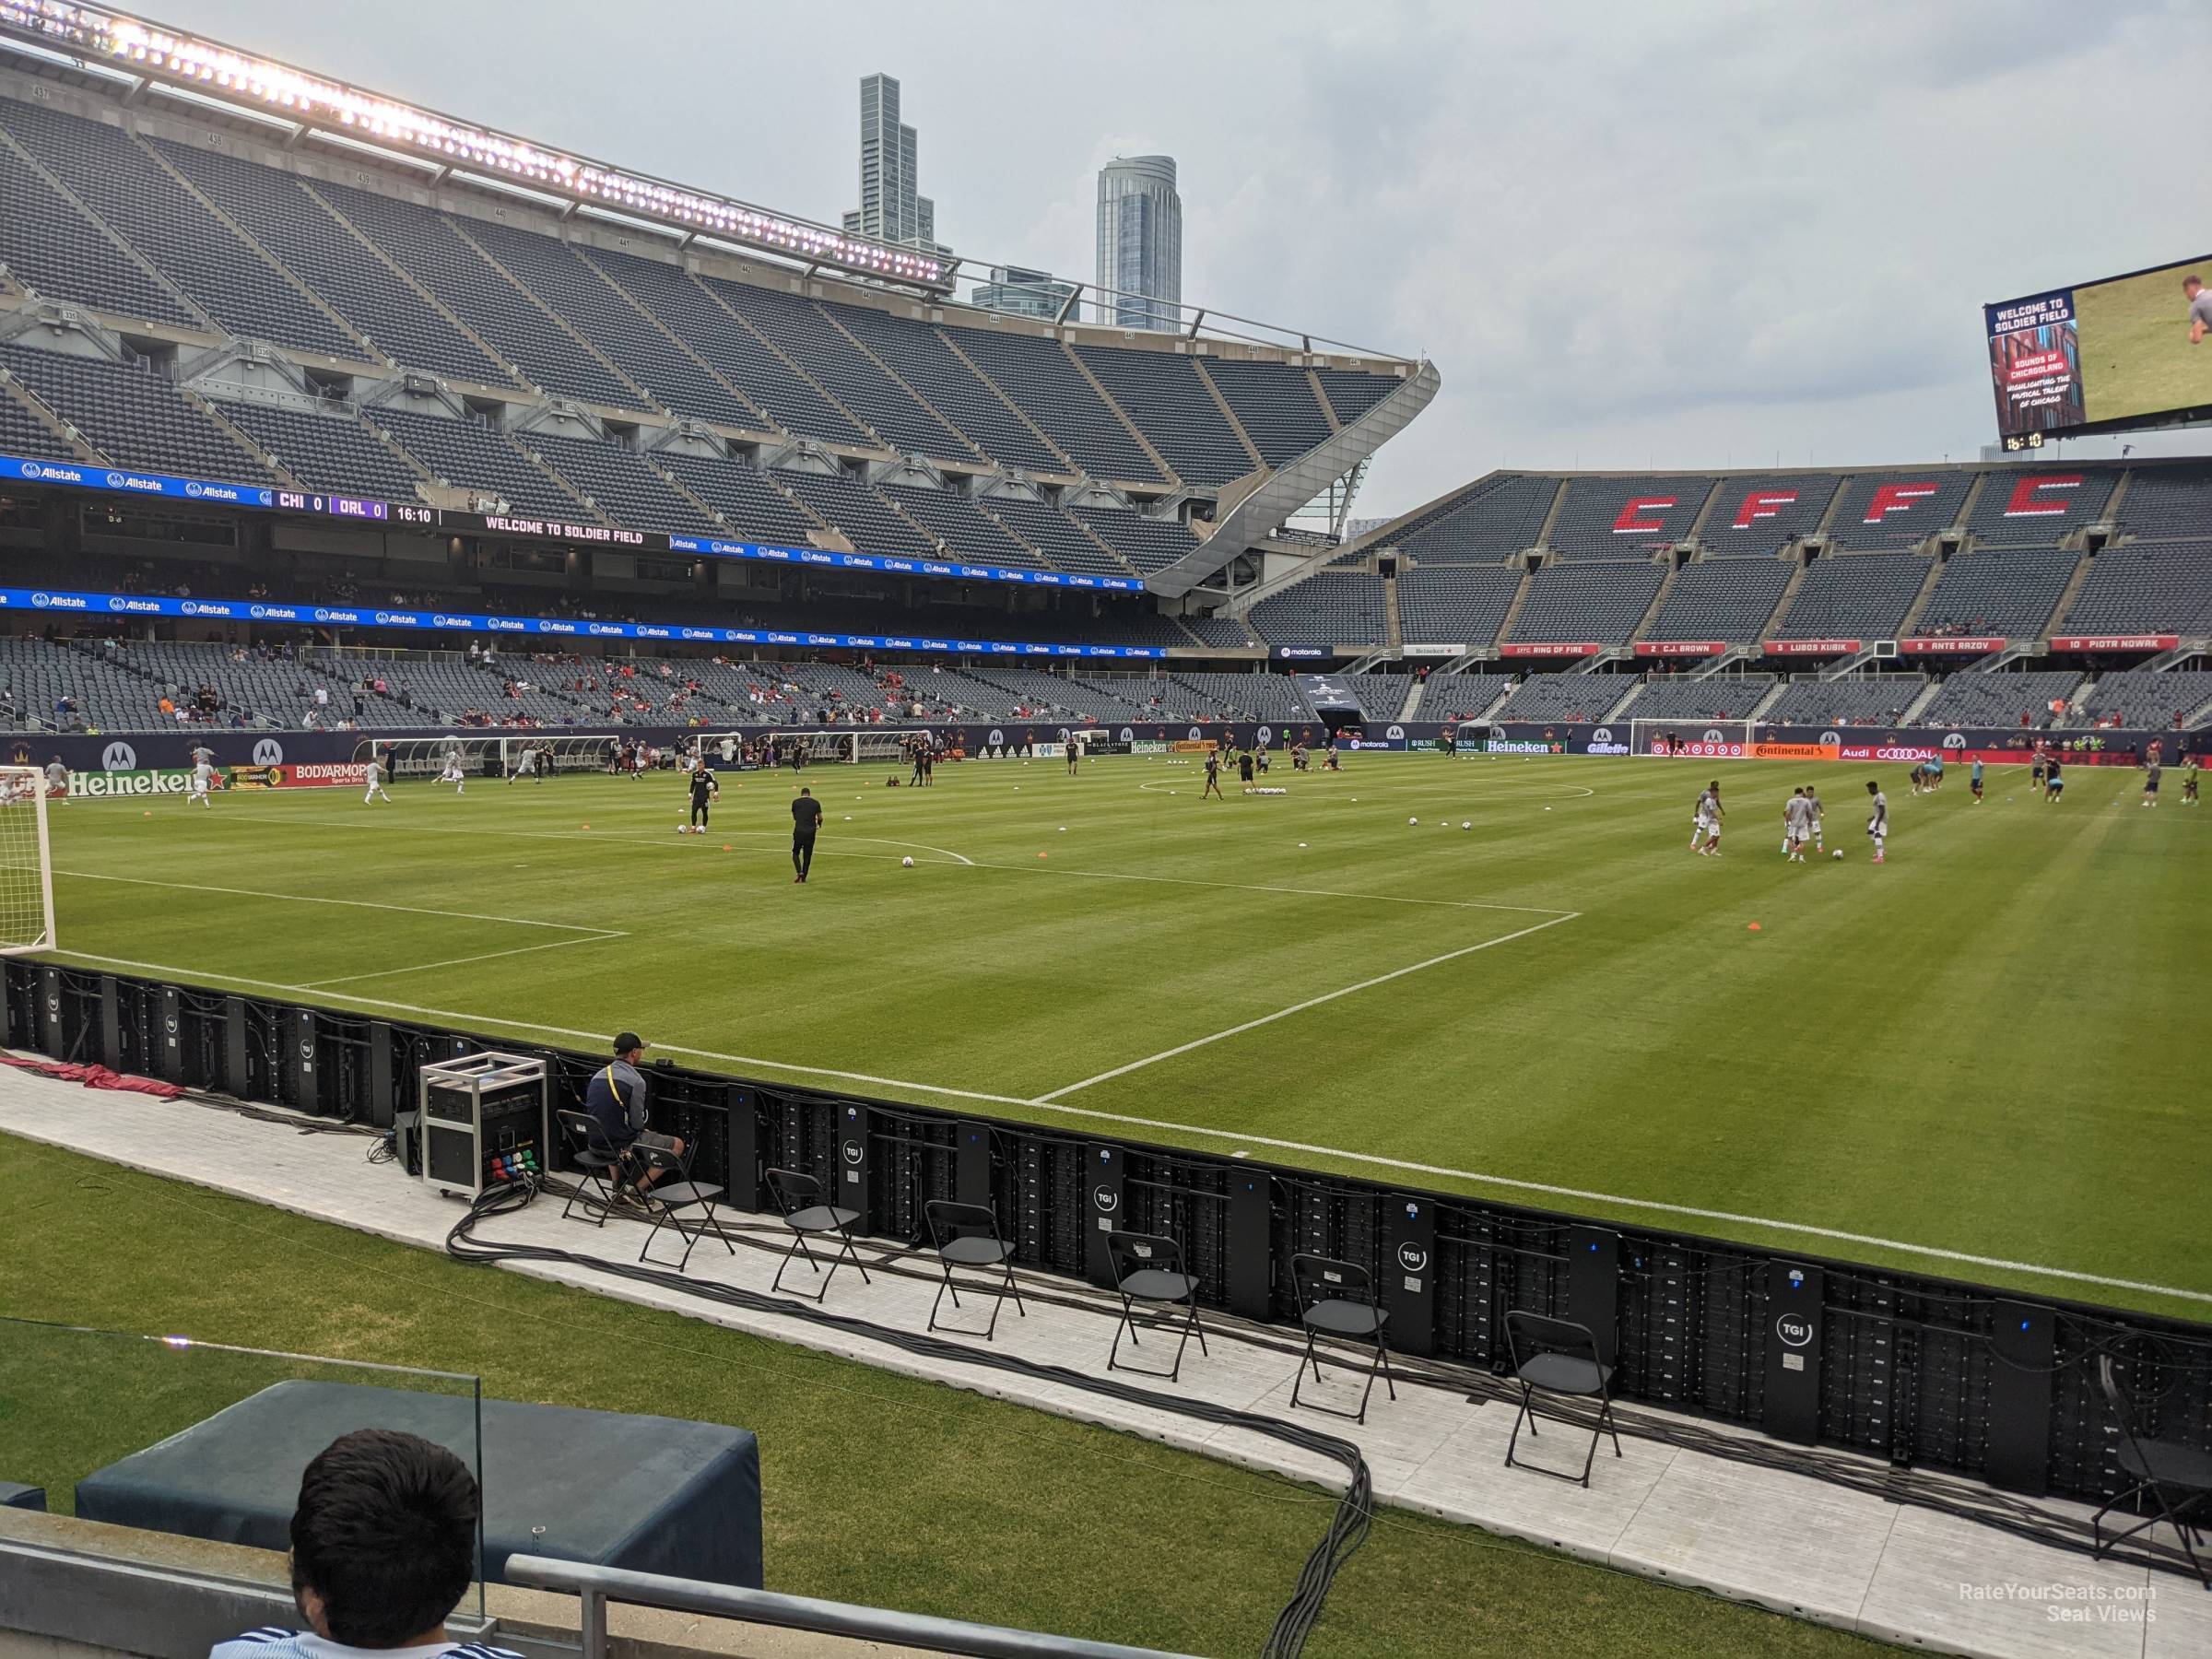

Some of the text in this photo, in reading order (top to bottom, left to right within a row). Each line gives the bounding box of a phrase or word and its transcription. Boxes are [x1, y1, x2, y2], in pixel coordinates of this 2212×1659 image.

[1997, 298, 2064, 321] WELCOME TO
[1994, 309, 2068, 333] SOLDIER FIELD
[2015, 354, 2058, 369] SOUNDS OF
[2010, 361, 2064, 379] CHICAGOLAND
[2007, 378, 2055, 393] HIGHLIGHTING
[2011, 384, 2069, 401] MUSICAL TALENT
[2030, 396, 2061, 406] CHICAGO
[40, 467, 80, 482] Allstate
[124, 477, 162, 491] Allstate
[202, 486, 238, 500] Allstate
[279, 492, 431, 523] CHI 0 ORL 0 16:10
[486, 515, 643, 544] WELCOME TO SOLDIER FIELD
[673, 540, 697, 549] Allstate
[721, 546, 744, 554] Allstate
[767, 550, 788, 559] Allstate
[809, 554, 830, 562] Allstate
[50, 597, 85, 607] Allstate
[124, 602, 159, 611] Allstate
[197, 606, 229, 615] Allstate
[264, 609, 295, 618] Allstate
[327, 613, 357, 621] Allstate
[389, 616, 416, 624] Allstate
[446, 618, 471, 627] Allstate
[500, 621, 524, 629] Allstate
[1534, 645, 1552, 653] RING
[1554, 645, 1565, 653] OF
[1566, 645, 1583, 653] FIRE
[1679, 644, 1710, 653] BROWN
[1821, 642, 1847, 651] KUBIK
[1932, 641, 1956, 650] ANTE
[1959, 641, 1989, 650] RAZOV
[2089, 640, 2118, 648] PIOTR
[2121, 640, 2159, 648] NOWAK
[1131, 740, 1167, 754] Heineken
[1488, 740, 1548, 754] Heineken
[1587, 743, 1629, 754] Gillette
[1756, 745, 1814, 757] Continental
[1841, 748, 1869, 757] Audi
[846, 1147, 858, 1158] TGI
[1098, 1193, 1112, 1204] TGI
[1403, 1251, 1419, 1263] TGI
[1783, 1324, 1804, 1336] TGI
